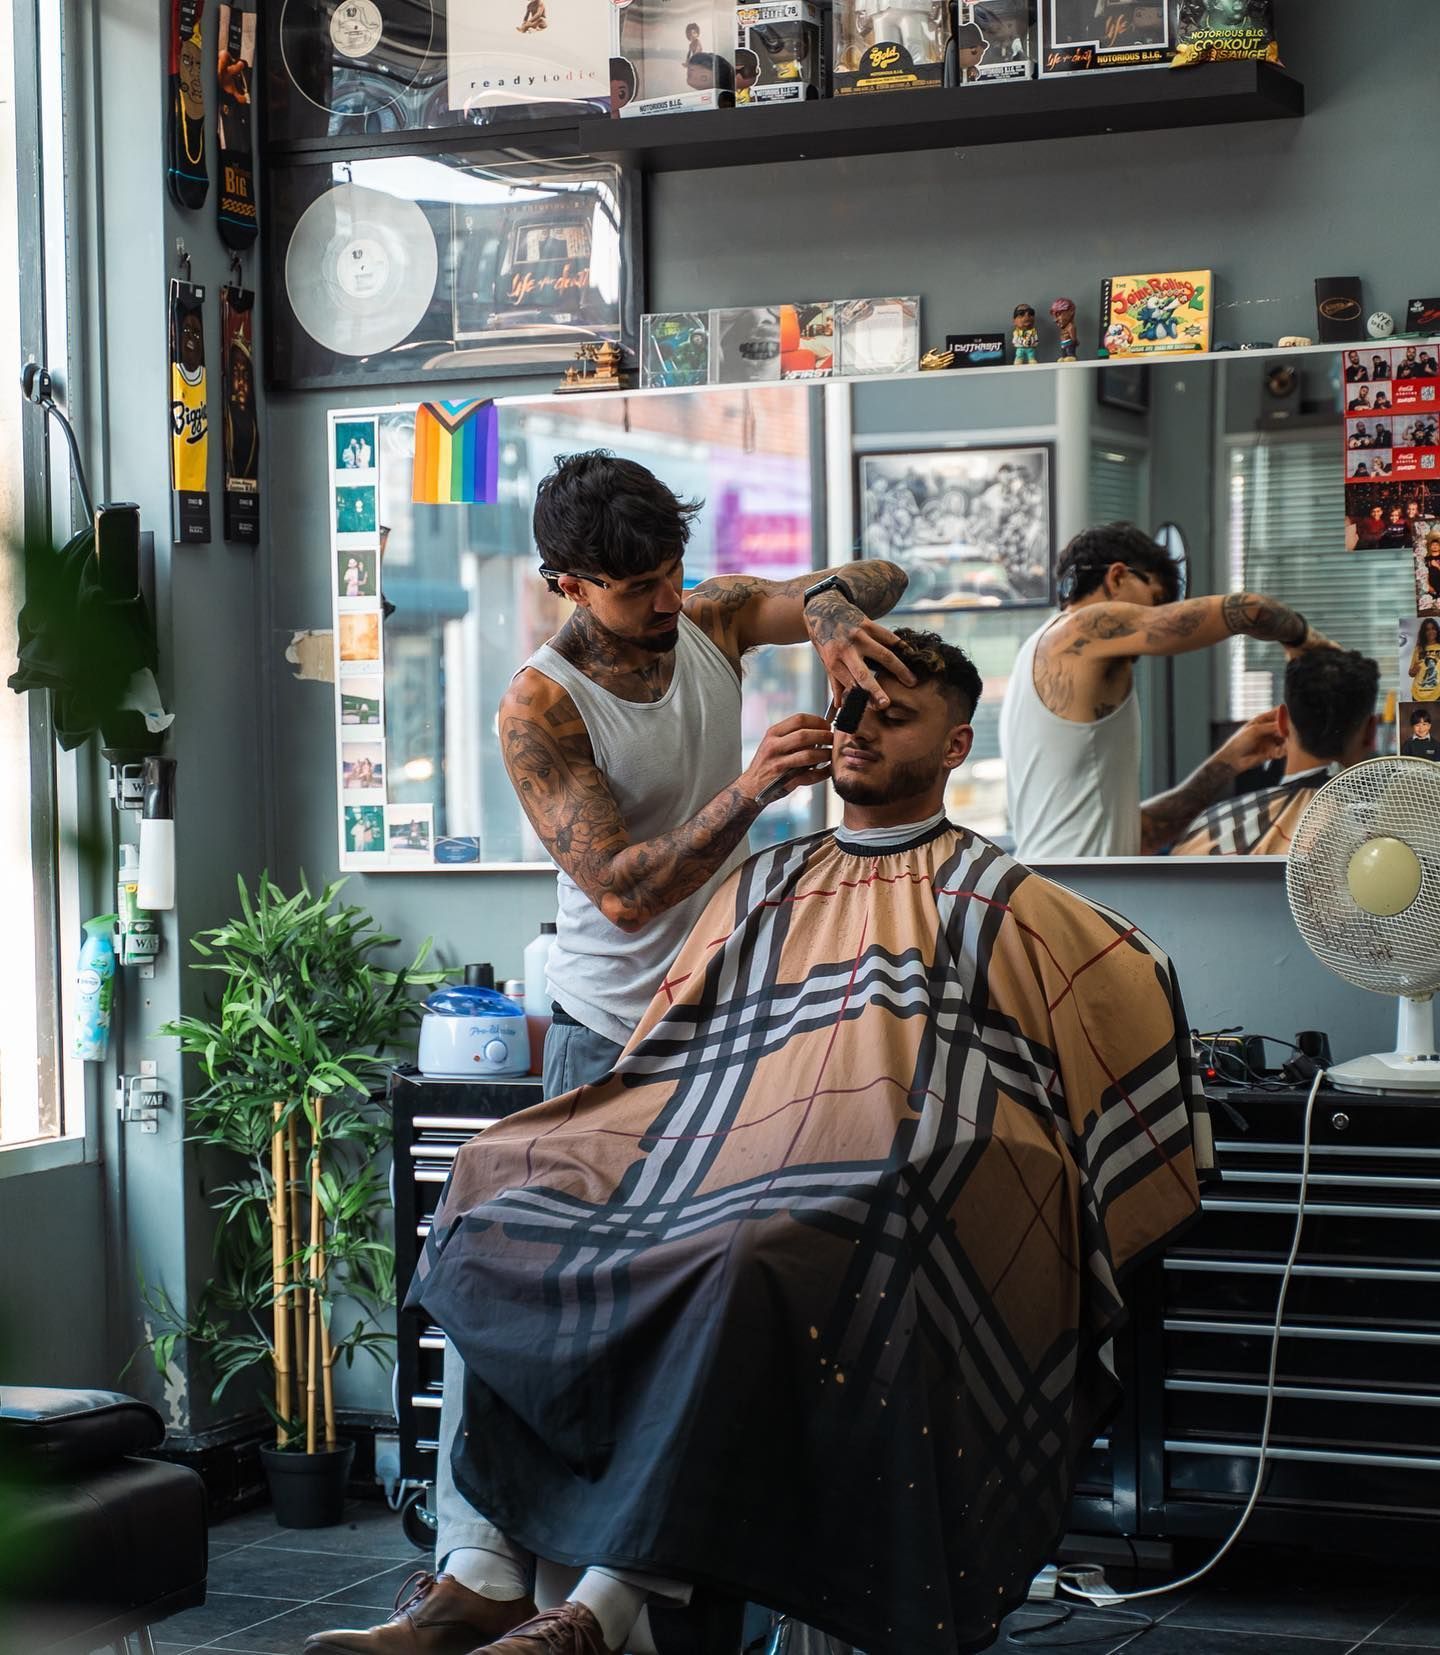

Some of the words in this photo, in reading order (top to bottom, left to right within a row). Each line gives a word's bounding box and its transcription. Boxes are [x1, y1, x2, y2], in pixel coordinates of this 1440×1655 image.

[1191, 29, 1243, 39] NOTORIOUS
[1194, 39, 1261, 51] COOKOUT
[1097, 52, 1140, 63] NOTORIOUS
